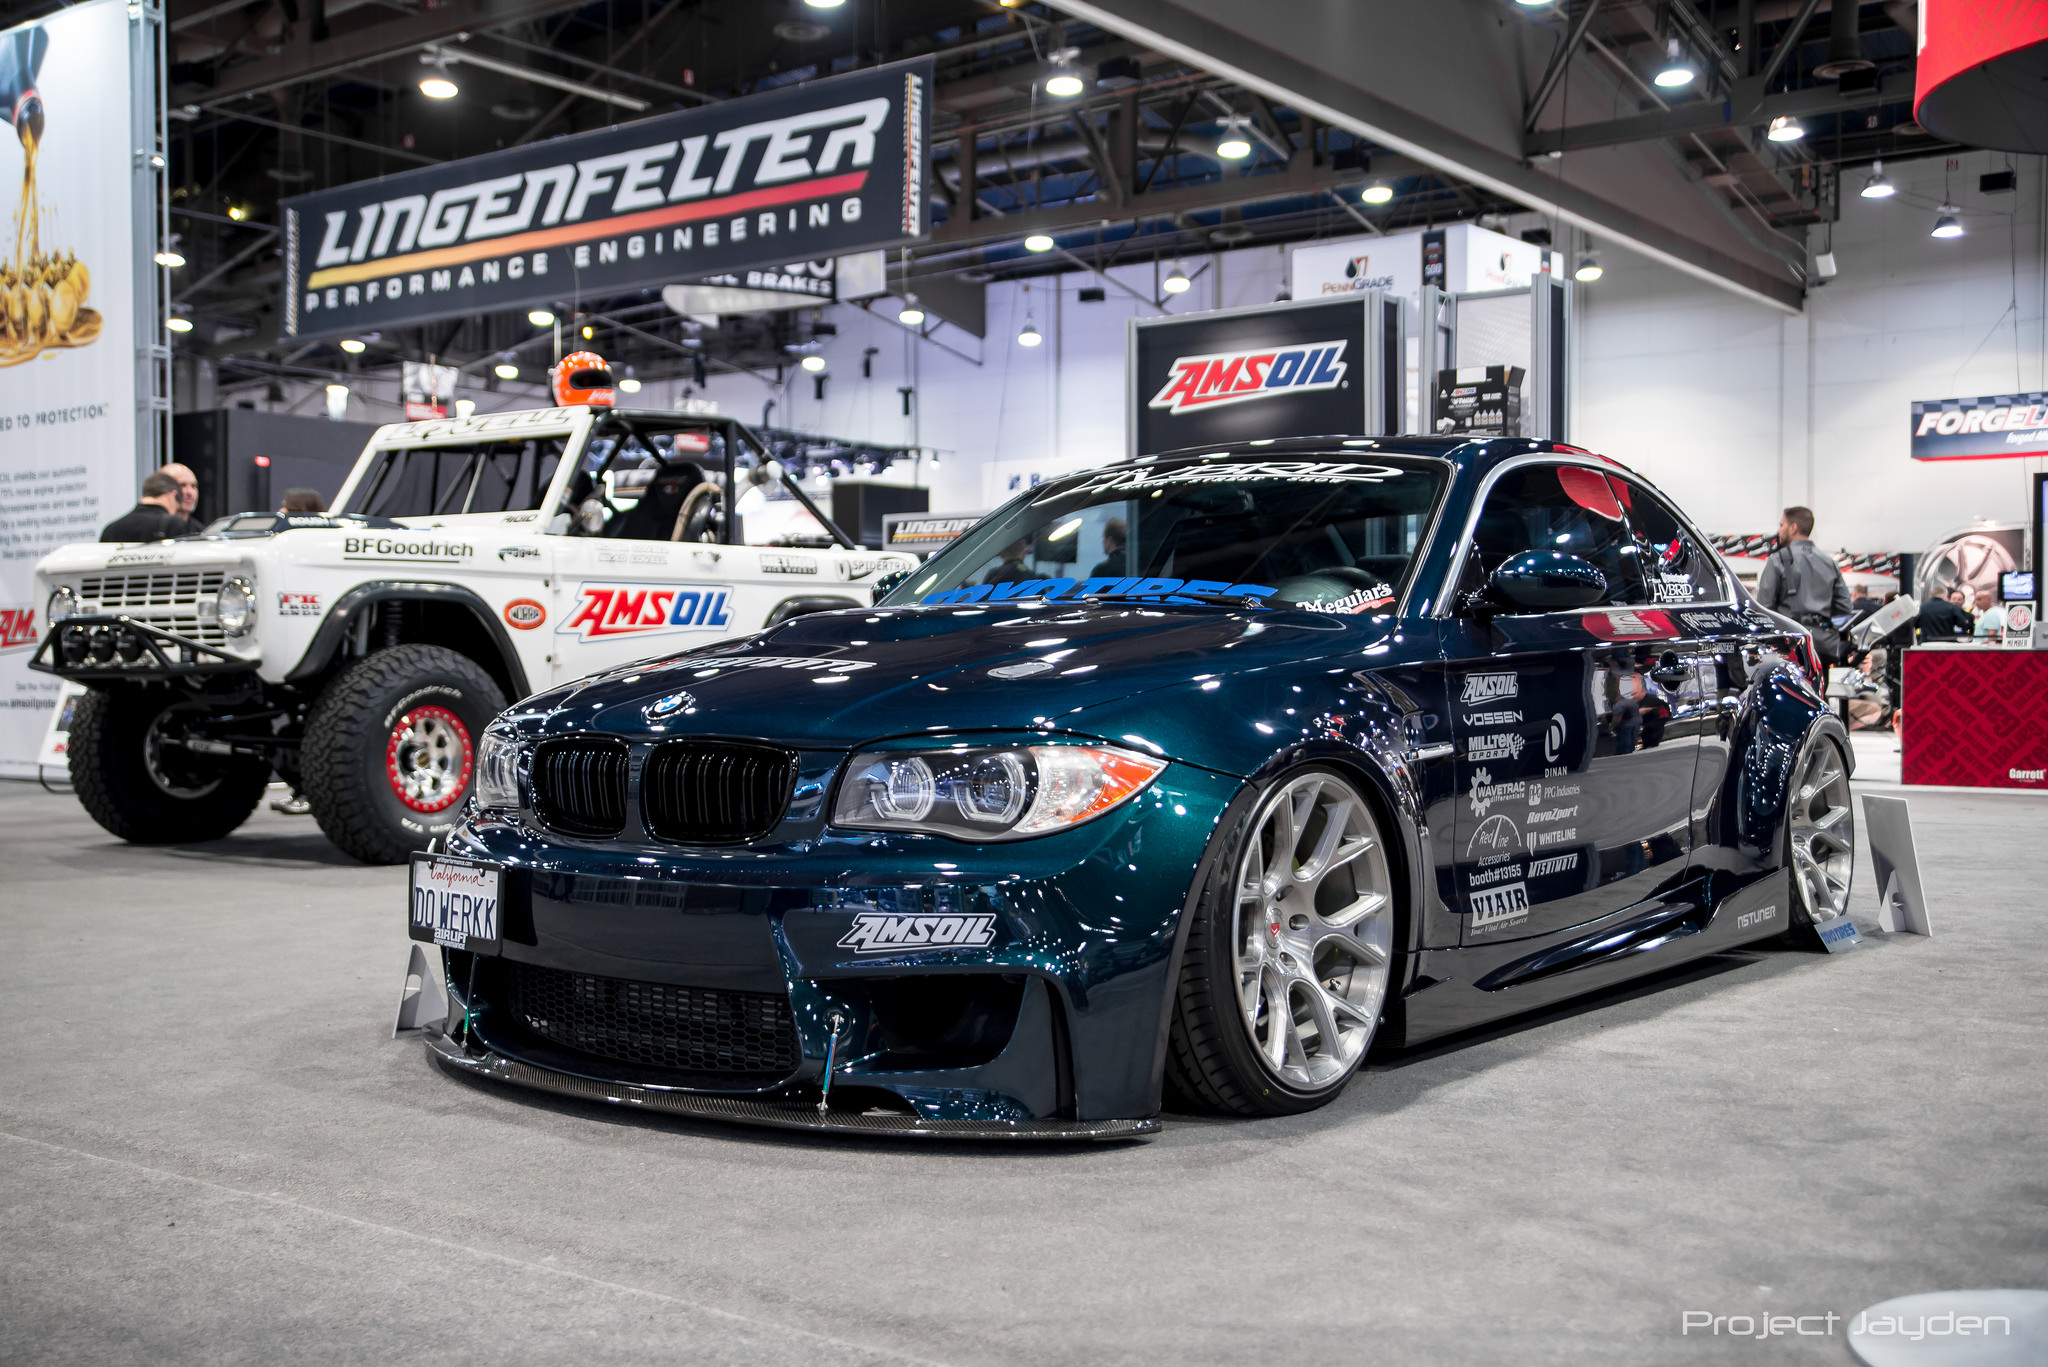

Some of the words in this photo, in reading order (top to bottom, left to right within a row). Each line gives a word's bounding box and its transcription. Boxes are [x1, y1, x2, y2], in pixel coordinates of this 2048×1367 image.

[316, 97, 889, 268] LINGENFELTER
[306, 253, 548, 313] PERFORMANCE
[575, 197, 862, 268] ENGINEERING
[747, 271, 833, 295] BRAKES
[1158, 346, 1342, 408] AMSOIL
[16, 414, 30, 427] TO
[344, 537, 473, 557] BFGoodrich
[1296, 582, 1393, 614] Meguiar's
[1653, 582, 1693, 602] HYBRID
[566, 588, 732, 638] AMSOIL
[2007, 639, 2028, 647] MEMBER
[1462, 674, 1517, 704] AMSOIL
[1463, 710, 1523, 726] VOSSEN
[1471, 750, 1506, 760] SPORT
[1545, 766, 1567, 777] DINAN
[2009, 768, 2044, 780] Garrett
[1478, 781, 1525, 798] WAVETRAC
[1490, 793, 1525, 803] differentials
[1544, 787, 1556, 799] PPG
[1556, 784, 1580, 796] Industries
[1539, 828, 1577, 845] WHITELINE
[1478, 851, 1511, 867] Accessories
[1527, 853, 1578, 878] MISHIMOTO
[431, 863, 485, 888] California
[1469, 864, 1522, 886] booth#13155
[413, 886, 435, 928] DO
[440, 890, 496, 940] WERKK
[1471, 887, 1528, 921] VIAIR
[844, 916, 992, 950] AMSOIL
[1485, 923, 1498, 932] Vital
[1509, 917, 1528, 926] Source
